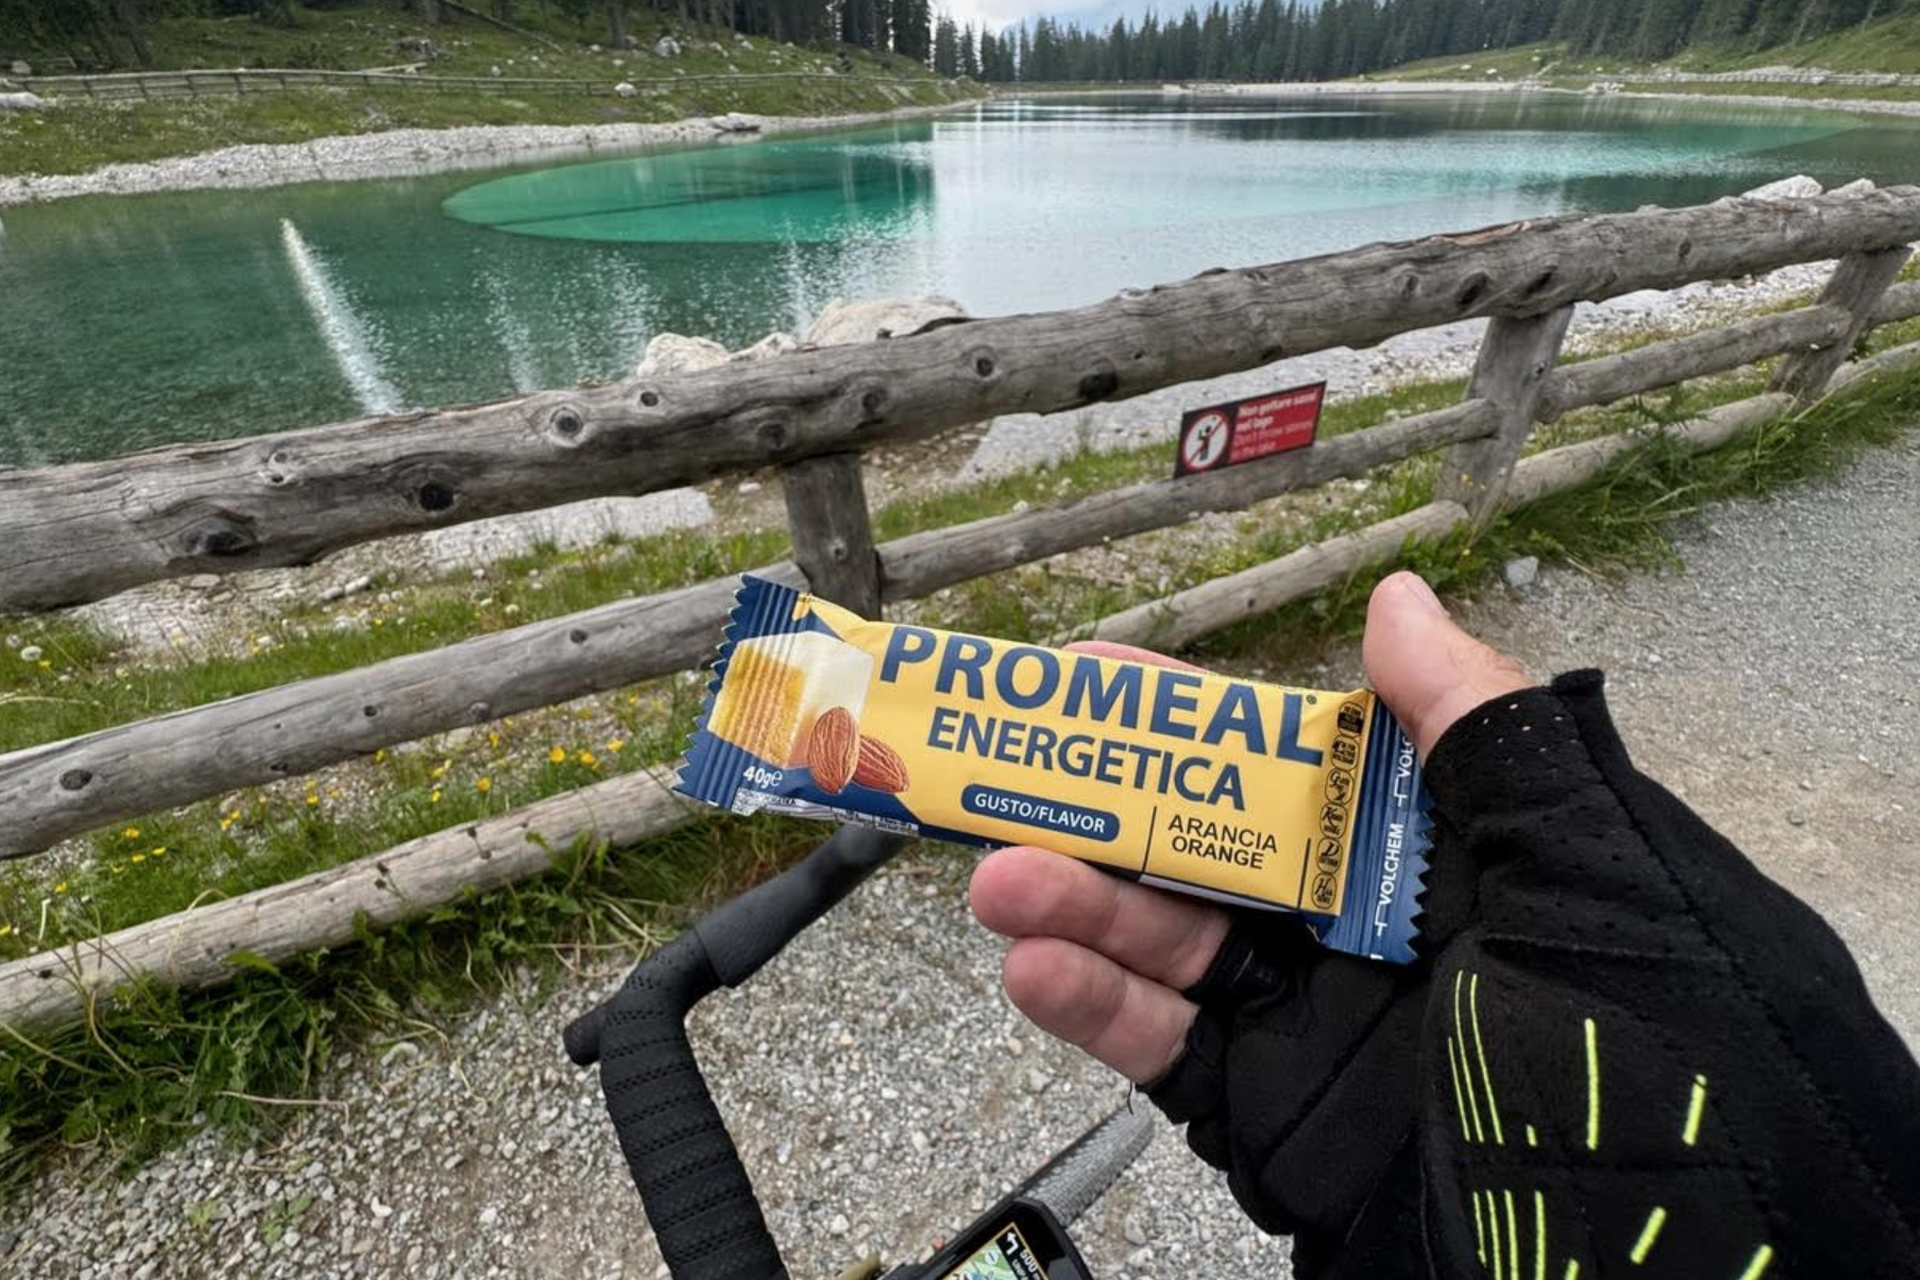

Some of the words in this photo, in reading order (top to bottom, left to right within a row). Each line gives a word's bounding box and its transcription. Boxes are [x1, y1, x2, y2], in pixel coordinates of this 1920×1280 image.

[926, 706, 1246, 812] ENERGETICA
[1397, 739, 1413, 778] VOLC
[973, 792, 1106, 834] GUSTO/FLAVOR
[1167, 814, 1278, 854] ARANCIA
[1171, 835, 1265, 870] ORANGE
[1378, 823, 1405, 905] VOLCHEM
